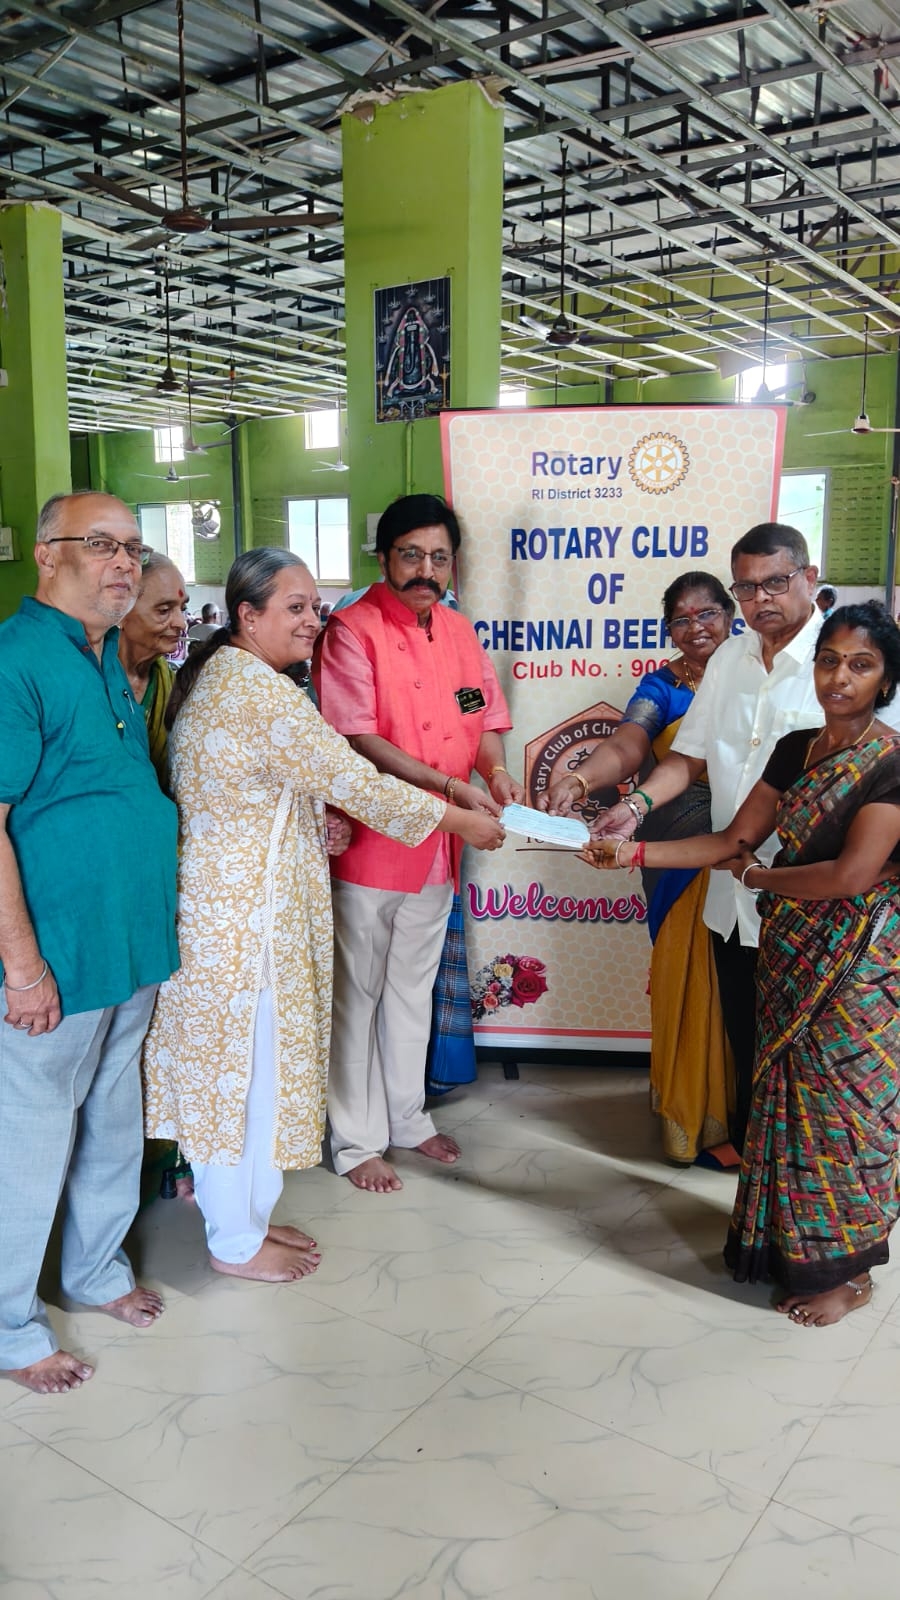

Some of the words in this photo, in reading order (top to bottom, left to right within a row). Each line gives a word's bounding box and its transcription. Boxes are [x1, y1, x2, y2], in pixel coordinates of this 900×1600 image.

[532, 451, 622, 480] Rotary
[532, 489, 544, 500] RI
[548, 488, 591, 500] District
[594, 487, 623, 498] 3233
[511, 526, 623, 560] ROTARY
[632, 526, 709, 558] CLUB
[588, 573, 625, 604] OF
[474, 618, 592, 651] CHENNAI
[513, 659, 563, 680] Club
[571, 658, 608, 678] No.
[535, 762, 552, 793] tary
[544, 733, 572, 760] Club
[574, 723, 588, 738] of
[467, 881, 648, 921] Welcomes
